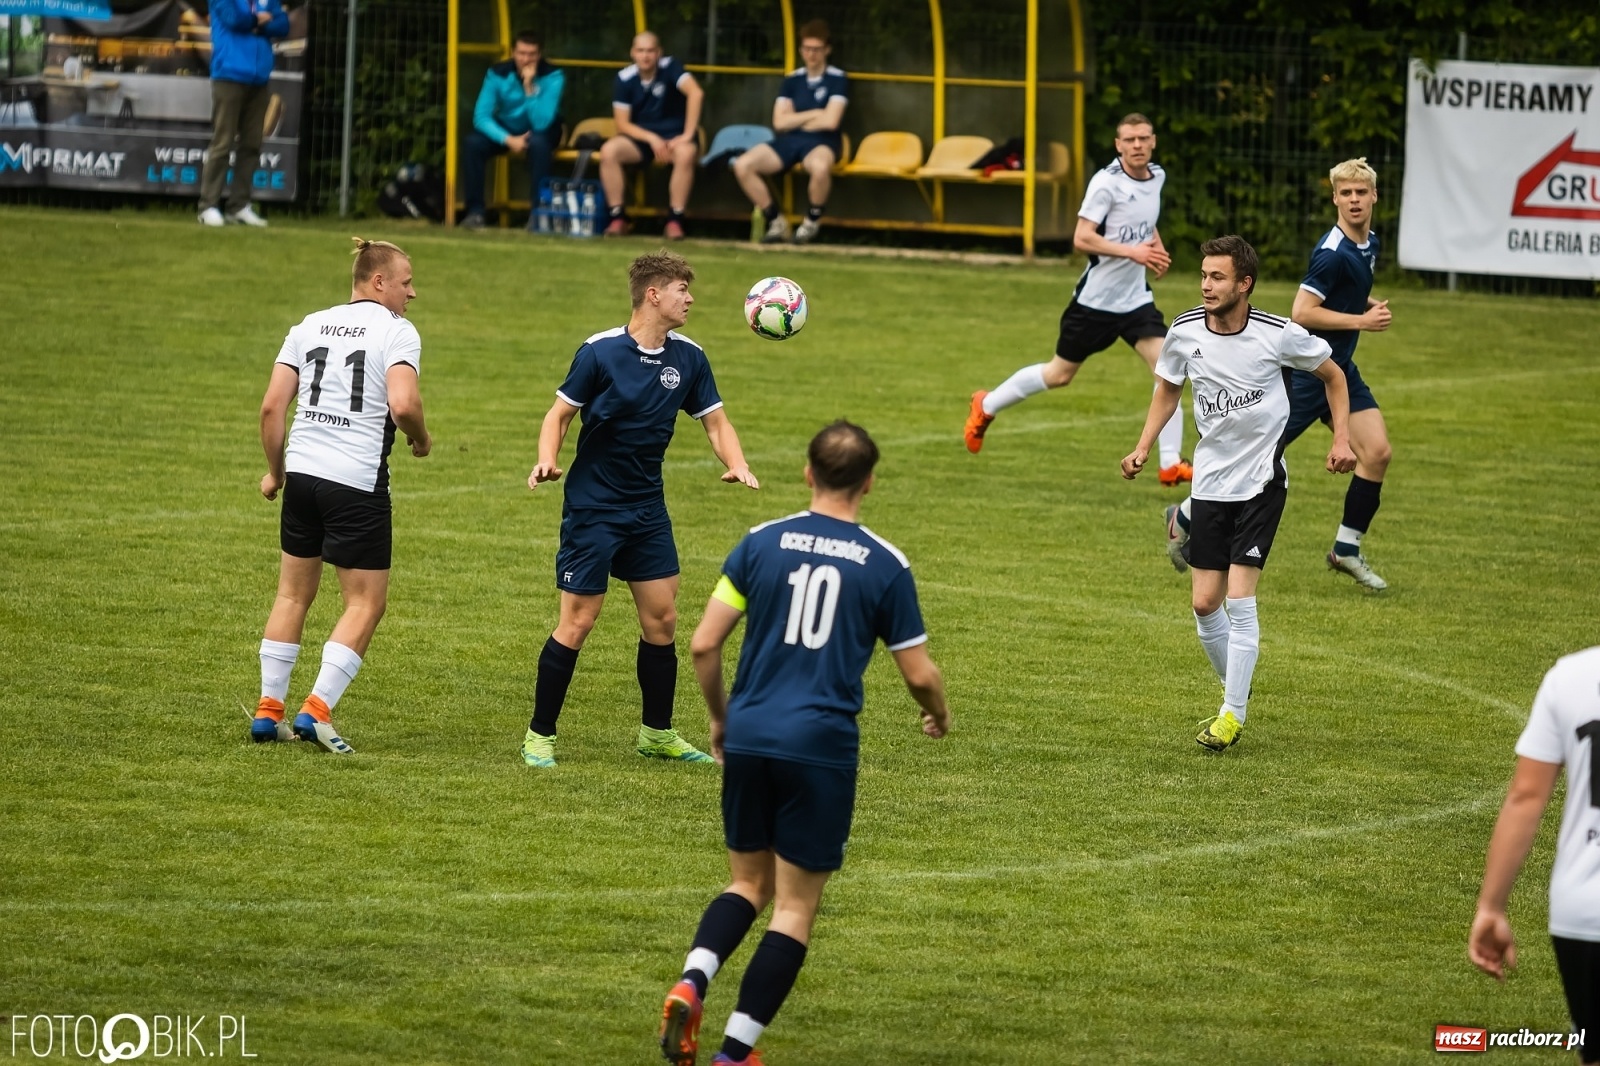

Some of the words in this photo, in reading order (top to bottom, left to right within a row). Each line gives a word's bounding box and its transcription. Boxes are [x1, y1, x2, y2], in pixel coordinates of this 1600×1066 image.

[1421, 76, 1593, 114] WSPIERAMY
[147, 165, 198, 184] LKS
[1507, 228, 1583, 256] GALERIA
[320, 325, 367, 338] WICHER
[305, 346, 366, 413] 11
[304, 410, 351, 428] PŁONIA
[783, 563, 842, 650] 10
